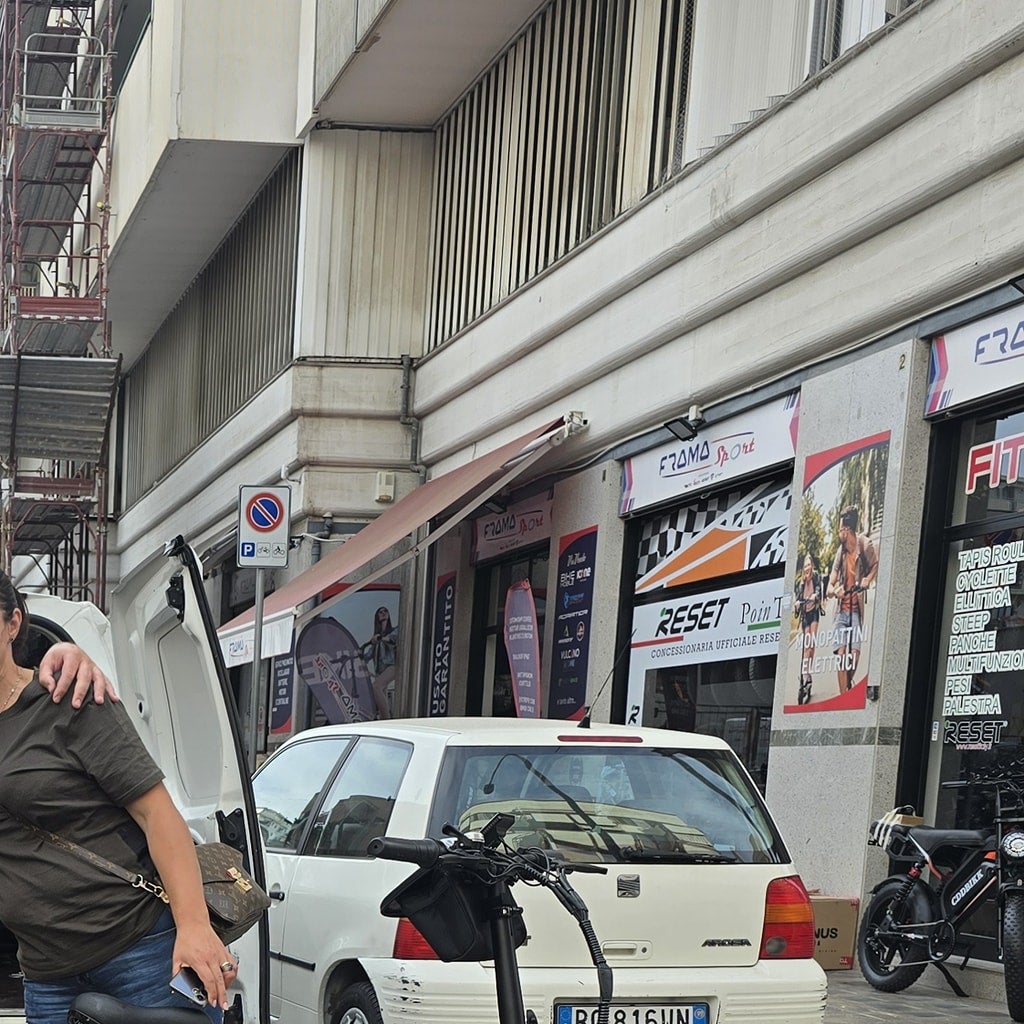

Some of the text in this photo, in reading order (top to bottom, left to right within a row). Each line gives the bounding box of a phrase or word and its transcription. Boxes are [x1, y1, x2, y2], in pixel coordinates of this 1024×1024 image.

[898, 353, 906, 371] 2
[659, 440, 711, 476] FRAMA
[484, 514, 516, 538] FRAMA
[243, 544, 253, 556] P
[958, 546, 992, 572] TAPIS
[655, 596, 731, 638] RESET
[951, 610, 991, 635] STEEP
[650, 639, 714, 659] CONCESSIONARIA
[715, 635, 758, 650] UFFICIALE
[795, 624, 868, 650] MONOPATTINI
[948, 630, 997, 656] PANCHE
[439, 585, 454, 714] GARANTITO
[802, 653, 857, 675] ELETTRICI
[432, 642, 443, 714] USATO
[944, 674, 973, 696] PESI
[942, 693, 1002, 717] PALESTRA
[944, 720, 1004, 744] RESET
